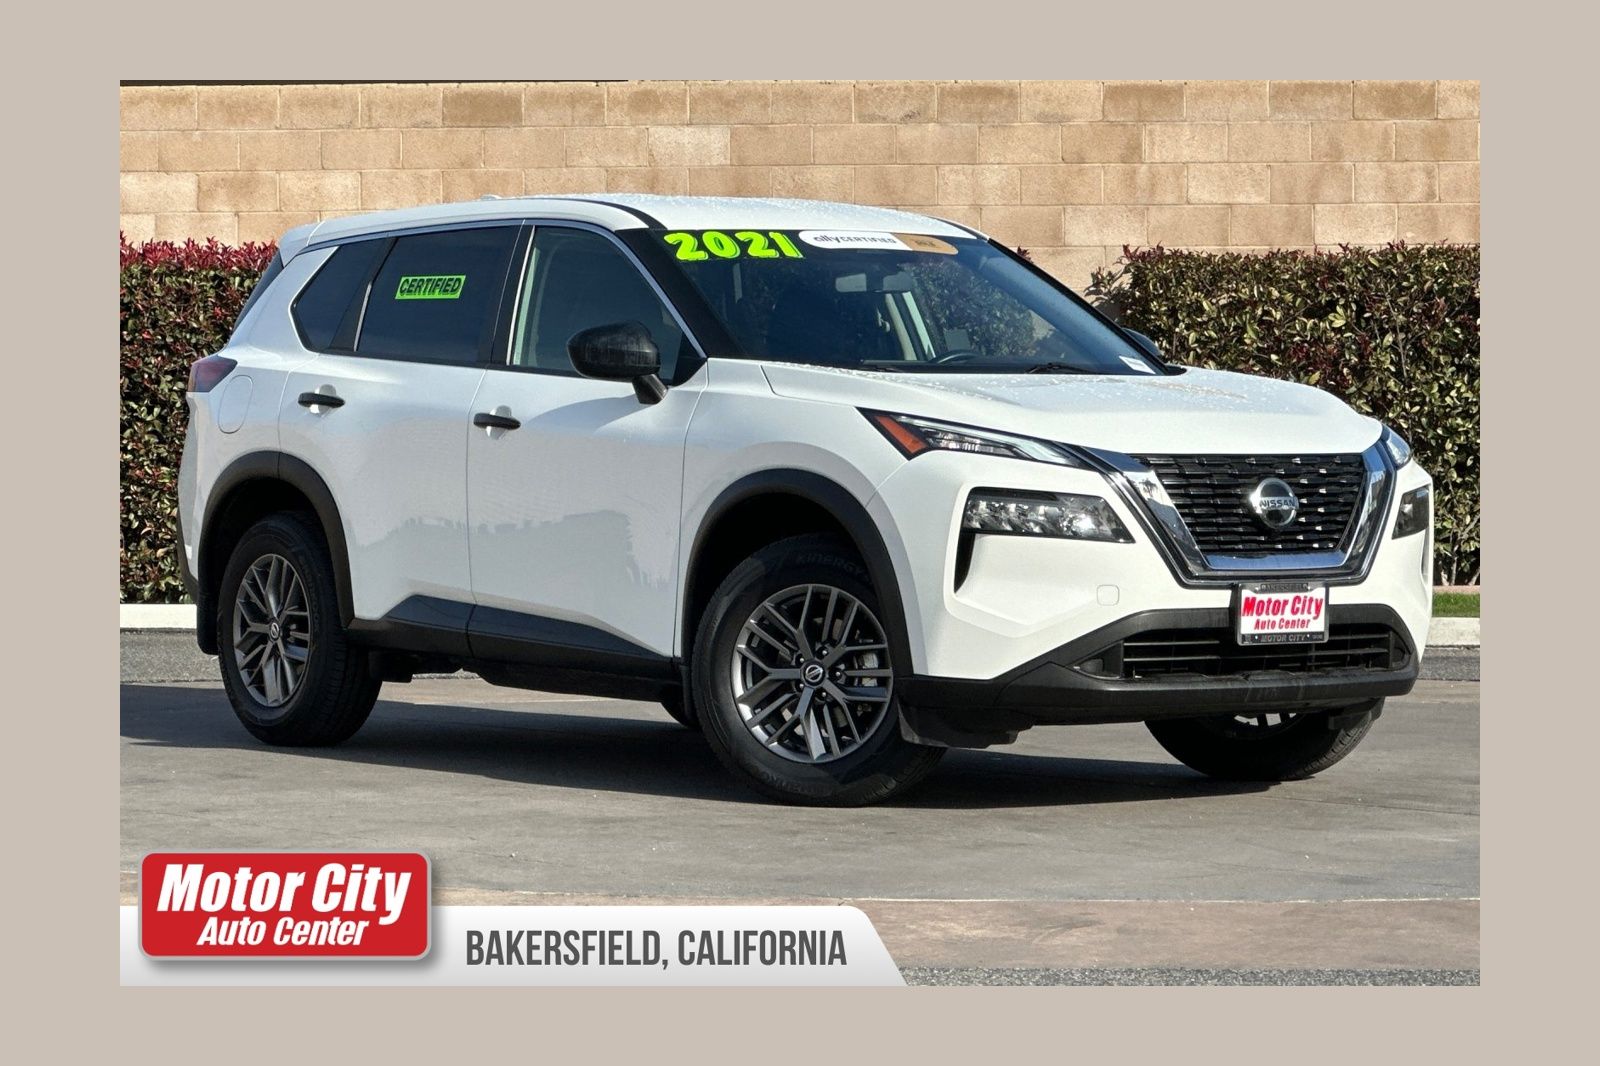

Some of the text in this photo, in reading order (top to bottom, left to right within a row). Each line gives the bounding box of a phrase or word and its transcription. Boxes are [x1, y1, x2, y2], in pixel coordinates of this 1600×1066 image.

[664, 231, 803, 261] 2021
[399, 278, 462, 296] CERTIFIED
[1260, 498, 1295, 508] NISSAN
[1242, 595, 1324, 619] Motor City
[1254, 618, 1311, 631] Auto Center
[1260, 635, 1287, 643] MOTOR
[1289, 633, 1306, 642] CITY
